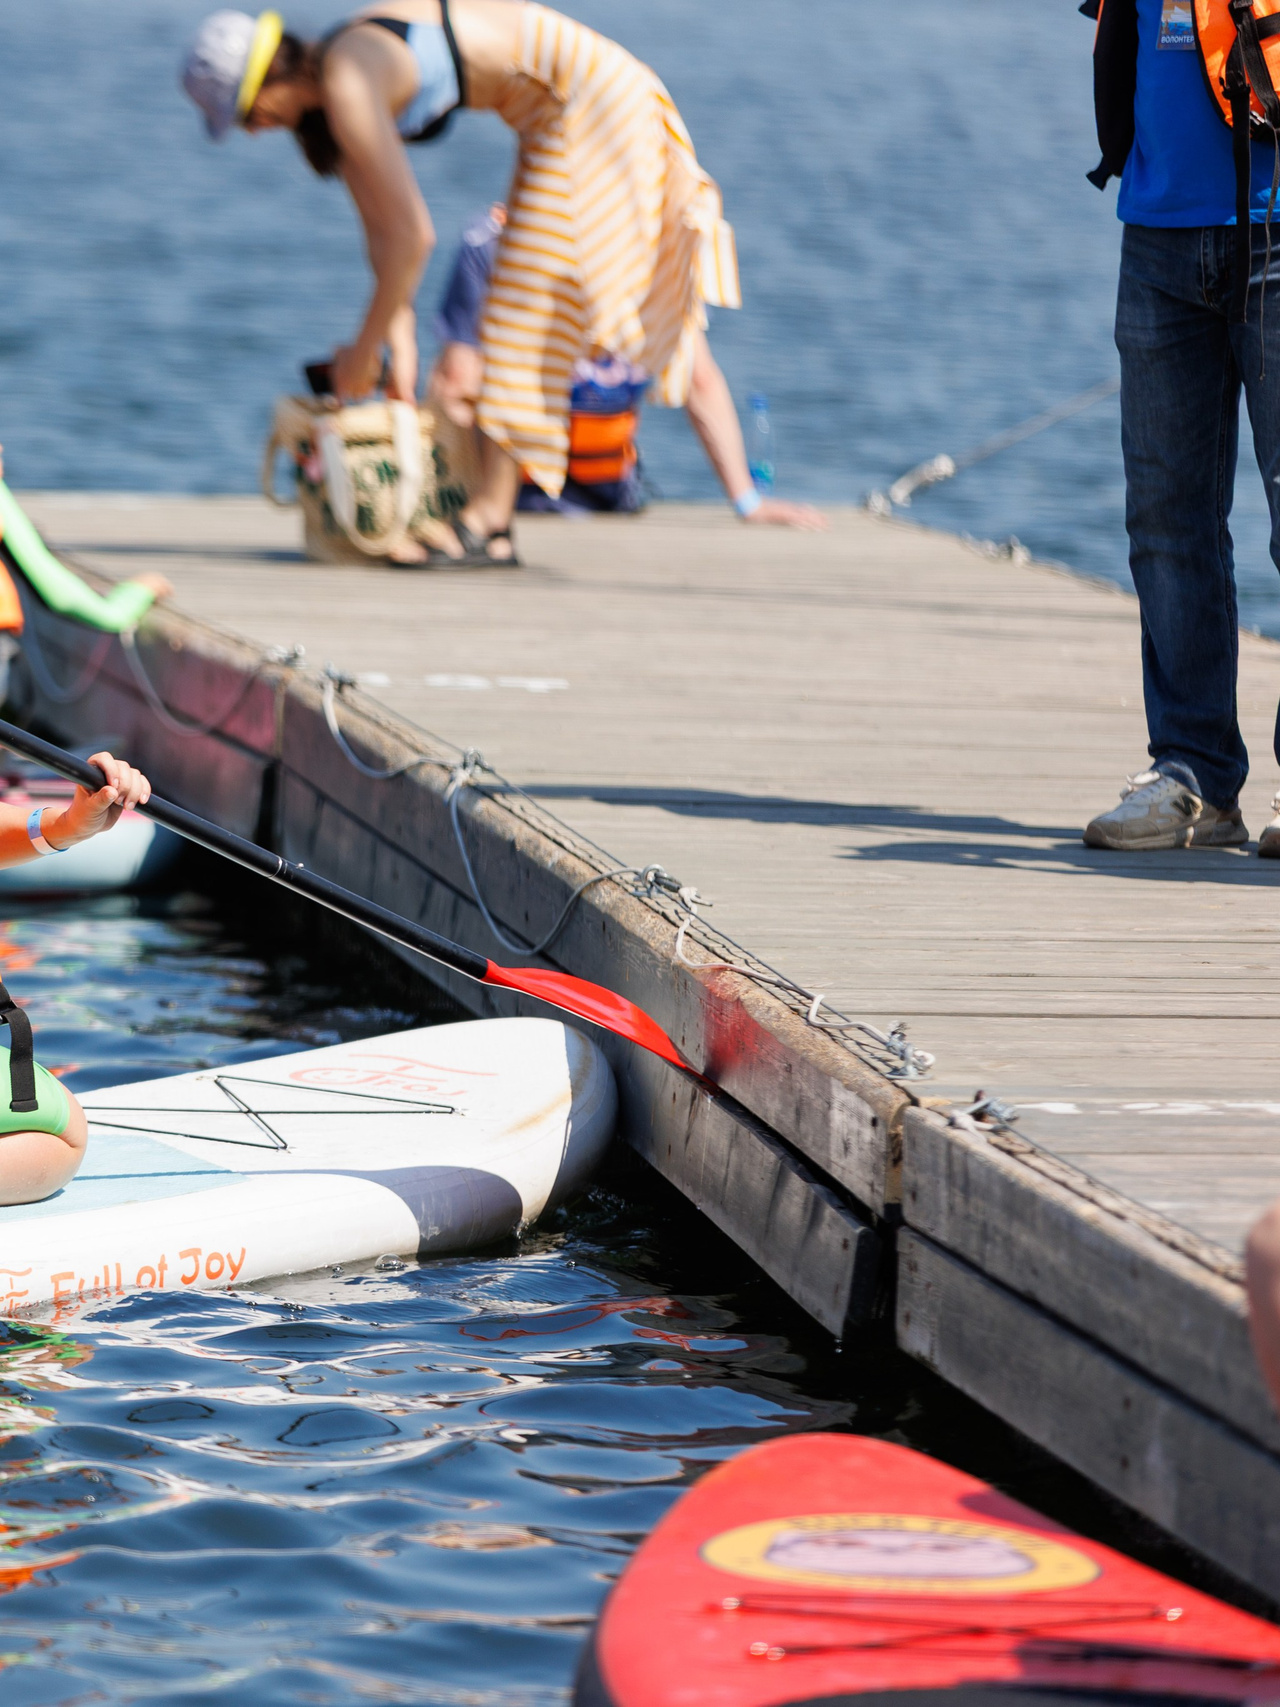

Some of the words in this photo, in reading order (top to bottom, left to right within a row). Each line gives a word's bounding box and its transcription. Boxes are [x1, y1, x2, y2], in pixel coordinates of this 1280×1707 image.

[1160, 35, 1195, 44] ВОЛОНТЕР
[50, 1262, 125, 1304] Full
[178, 1246, 246, 1285] Joy
